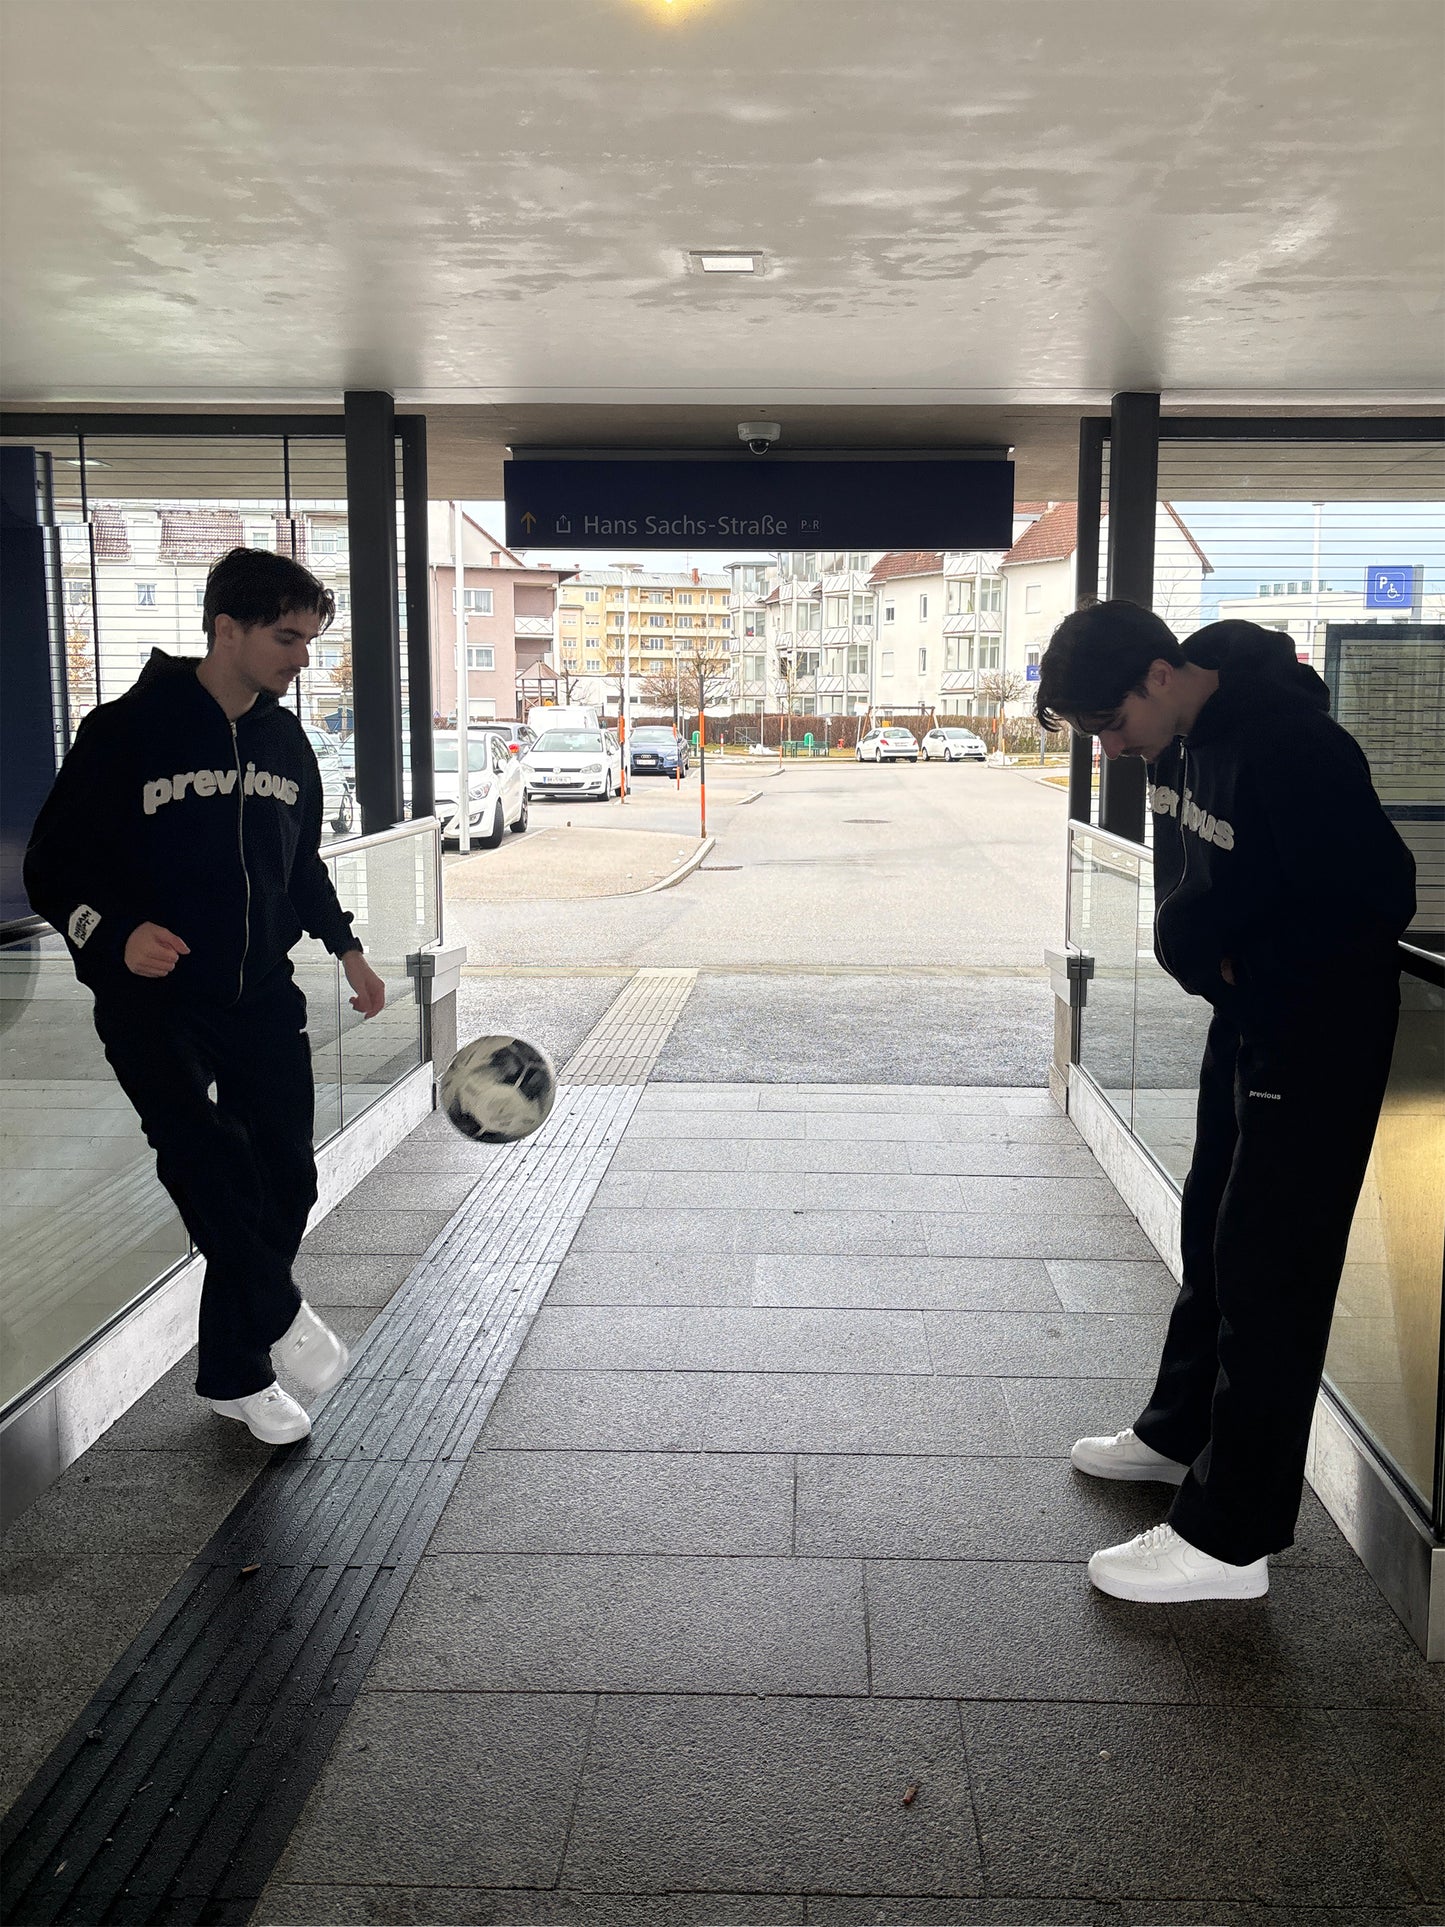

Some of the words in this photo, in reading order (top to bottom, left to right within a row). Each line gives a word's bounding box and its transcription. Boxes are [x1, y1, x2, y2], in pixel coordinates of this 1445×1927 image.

[584, 515, 638, 535] Hans
[645, 515, 788, 535] Sachs-Straße
[143, 761, 300, 815] previous
[1148, 784, 1235, 851] evious
[1249, 1090, 1281, 1100] previous
